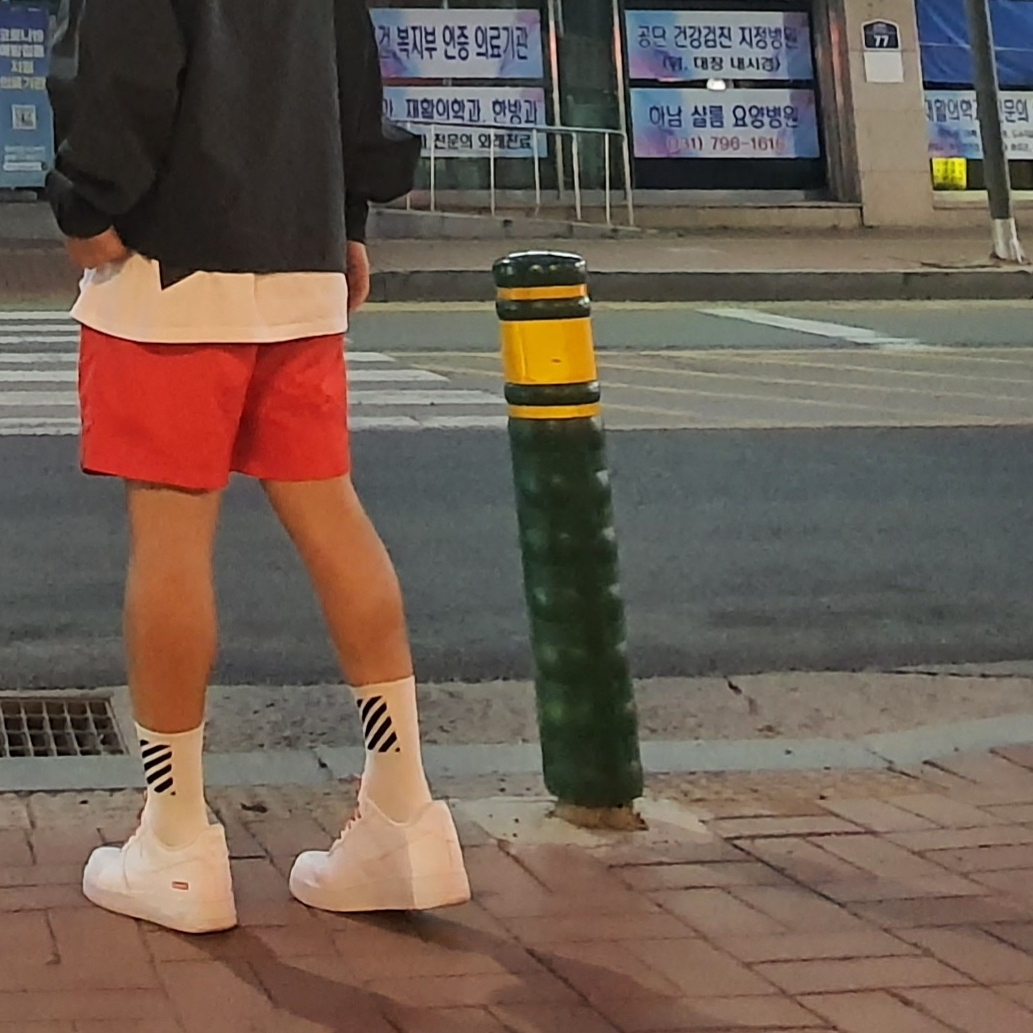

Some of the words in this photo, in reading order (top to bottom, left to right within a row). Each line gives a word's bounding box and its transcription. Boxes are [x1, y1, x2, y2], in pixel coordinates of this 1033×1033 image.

[379, 25, 392, 59] 건
[397, 25, 437, 60] 복지부
[442, 25, 470, 60] 인증
[474, 25, 529, 60] 의료기관
[638, 25, 668, 49] 공단
[674, 25, 732, 49] 건강검진
[739, 25, 799, 50] 지정병원
[873, 35, 889, 47] 77
[693, 56, 724, 71] 대장
[730, 56, 781, 72] 내시경)
[492, 99, 537, 125] 한방과
[648, 105, 683, 128] 하남
[732, 105, 800, 129] 요양병원
[925, 99, 976, 123] 재활의학
[999, 99, 1029, 123] 문의
[434, 133, 473, 149] 전문의
